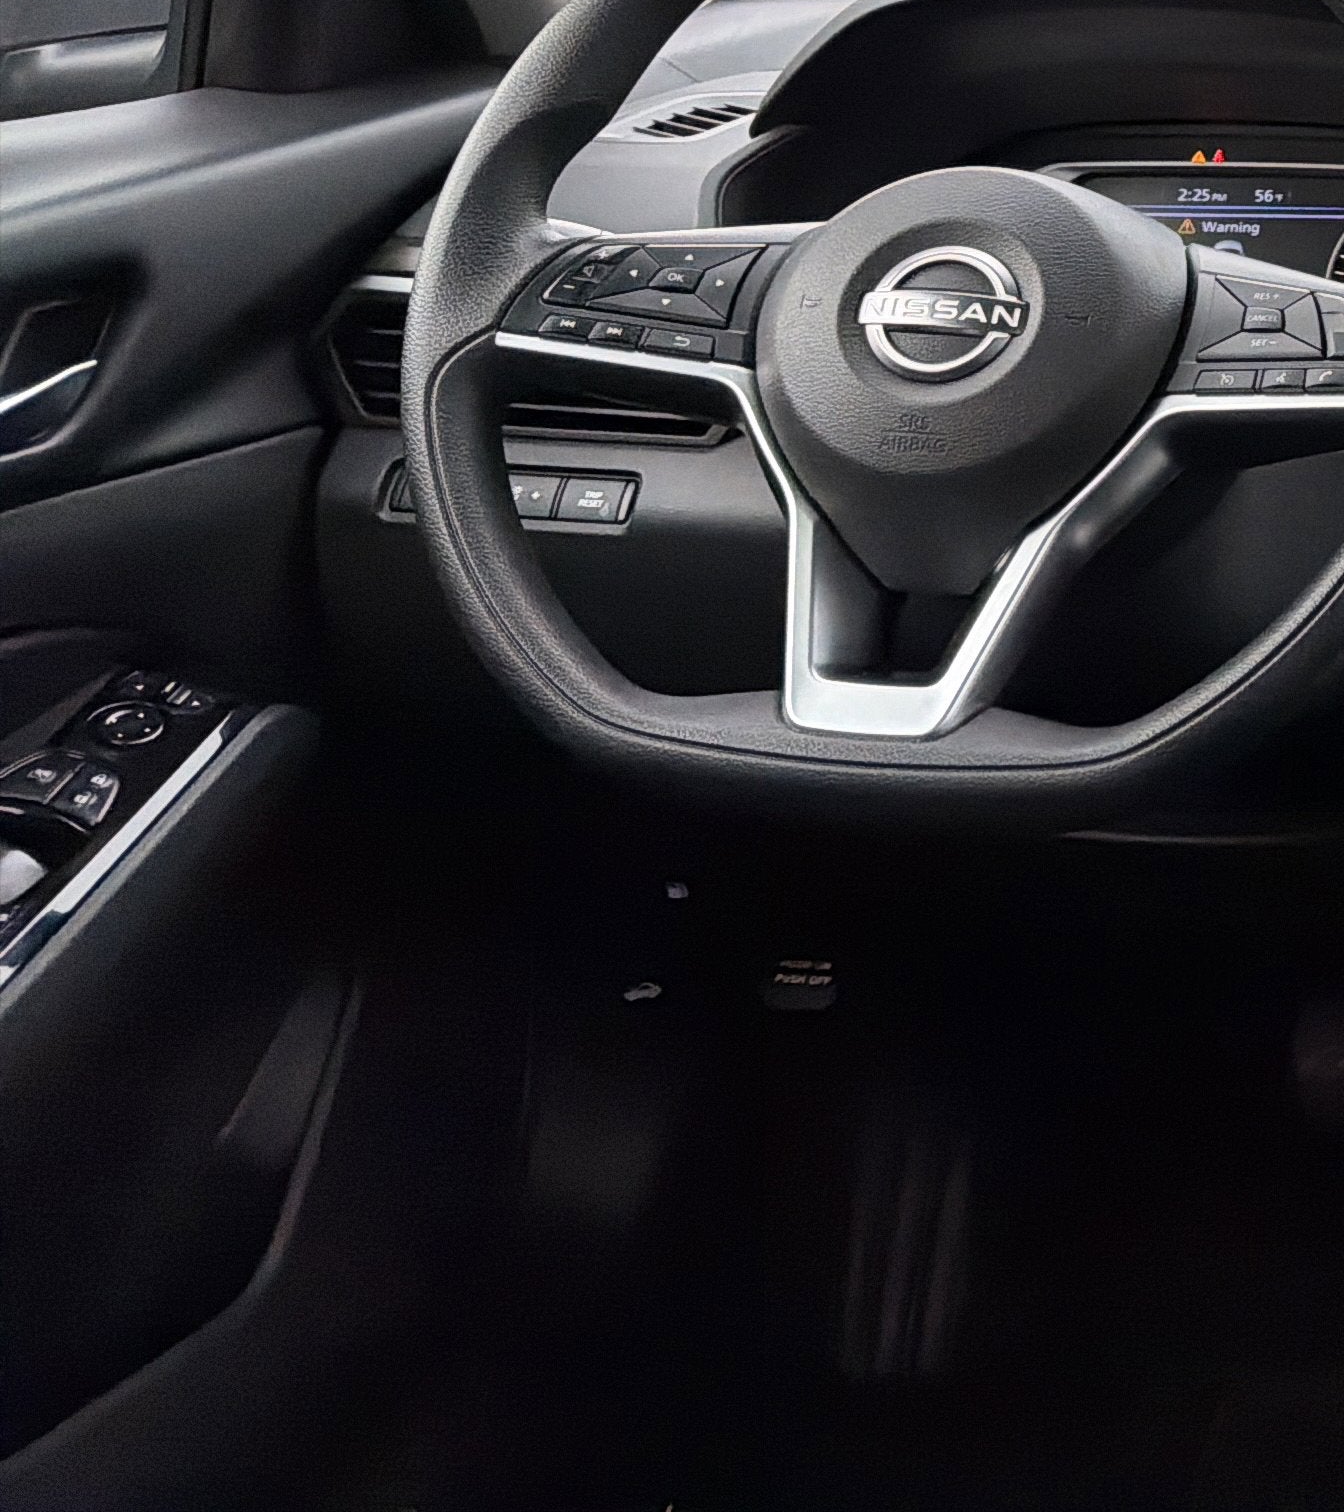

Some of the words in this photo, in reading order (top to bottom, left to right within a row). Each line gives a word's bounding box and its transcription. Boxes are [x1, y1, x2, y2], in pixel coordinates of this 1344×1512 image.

[1177, 188, 1211, 203] 2:25
[1202, 221, 1261, 236] Warning
[667, 272, 685, 283] OK
[863, 297, 1022, 328] NISSAN
[1247, 314, 1279, 323] CANCEL
